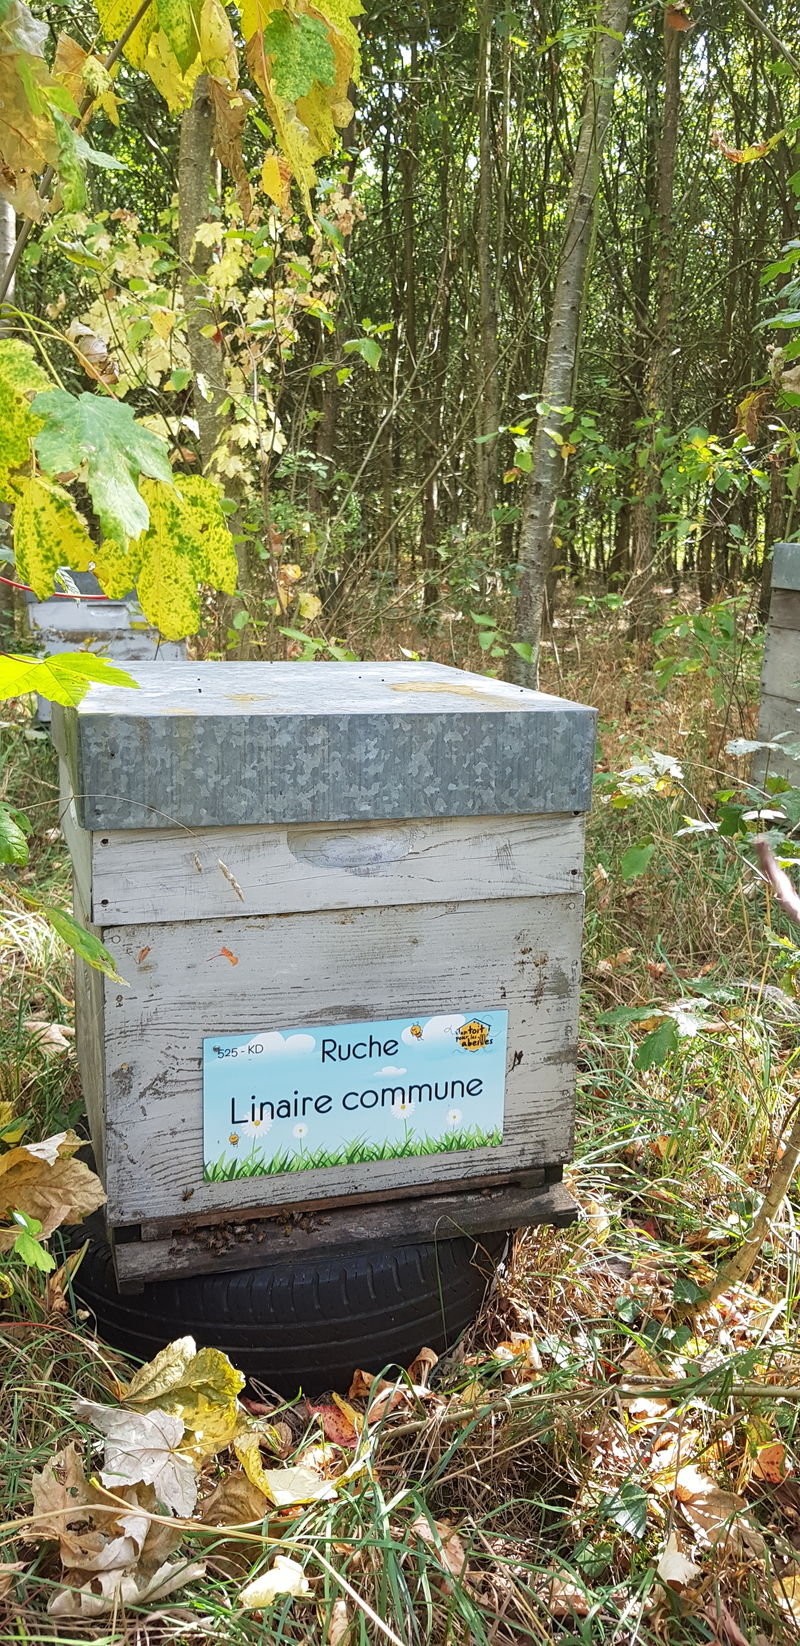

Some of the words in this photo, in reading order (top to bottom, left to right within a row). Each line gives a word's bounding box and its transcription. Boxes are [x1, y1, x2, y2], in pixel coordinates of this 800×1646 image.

[468, 1025, 485, 1034] toit
[461, 1034, 493, 1046] abeilles
[217, 1048, 238, 1059] 525
[248, 1044, 264, 1055] KD
[321, 1035, 399, 1063] Ruche
[231, 1090, 333, 1125] Linaire
[342, 1078, 483, 1111] commune
